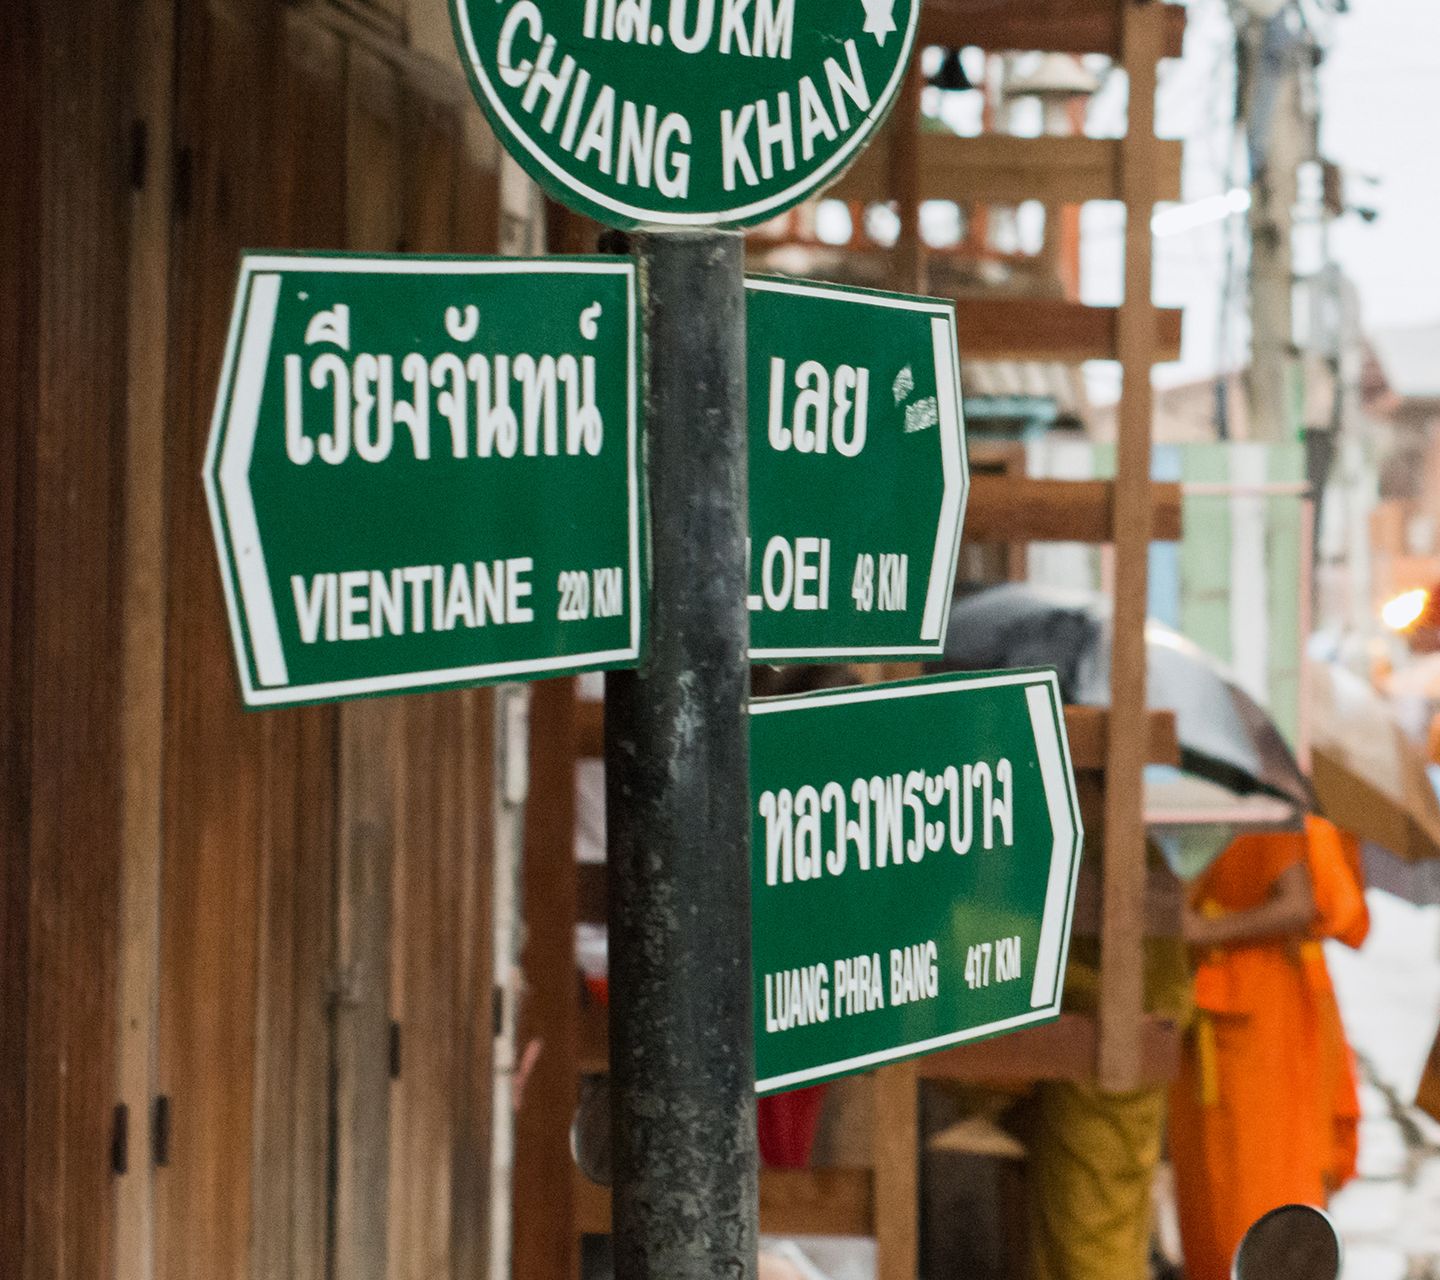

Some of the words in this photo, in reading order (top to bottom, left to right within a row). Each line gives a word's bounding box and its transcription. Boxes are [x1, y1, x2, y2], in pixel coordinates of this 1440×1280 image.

[496, 0, 692, 200] CHIANG
[720, 38, 871, 192] KHAN
[284, 301, 603, 466] เวียงจันทน์
[767, 356, 870, 458] เลย
[290, 556, 534, 644] VIENTIANE
[557, 570, 590, 621] 220
[593, 566, 623, 618] KM
[851, 553, 875, 612] 48
[877, 553, 909, 612] KM
[758, 757, 1014, 886] หลวงพระบาง
[765, 962, 830, 1033] LUANG
[834, 952, 885, 1018] PHRA
[890, 939, 939, 1007] BANG
[963, 942, 993, 990] 417
[995, 934, 1022, 983] KM
